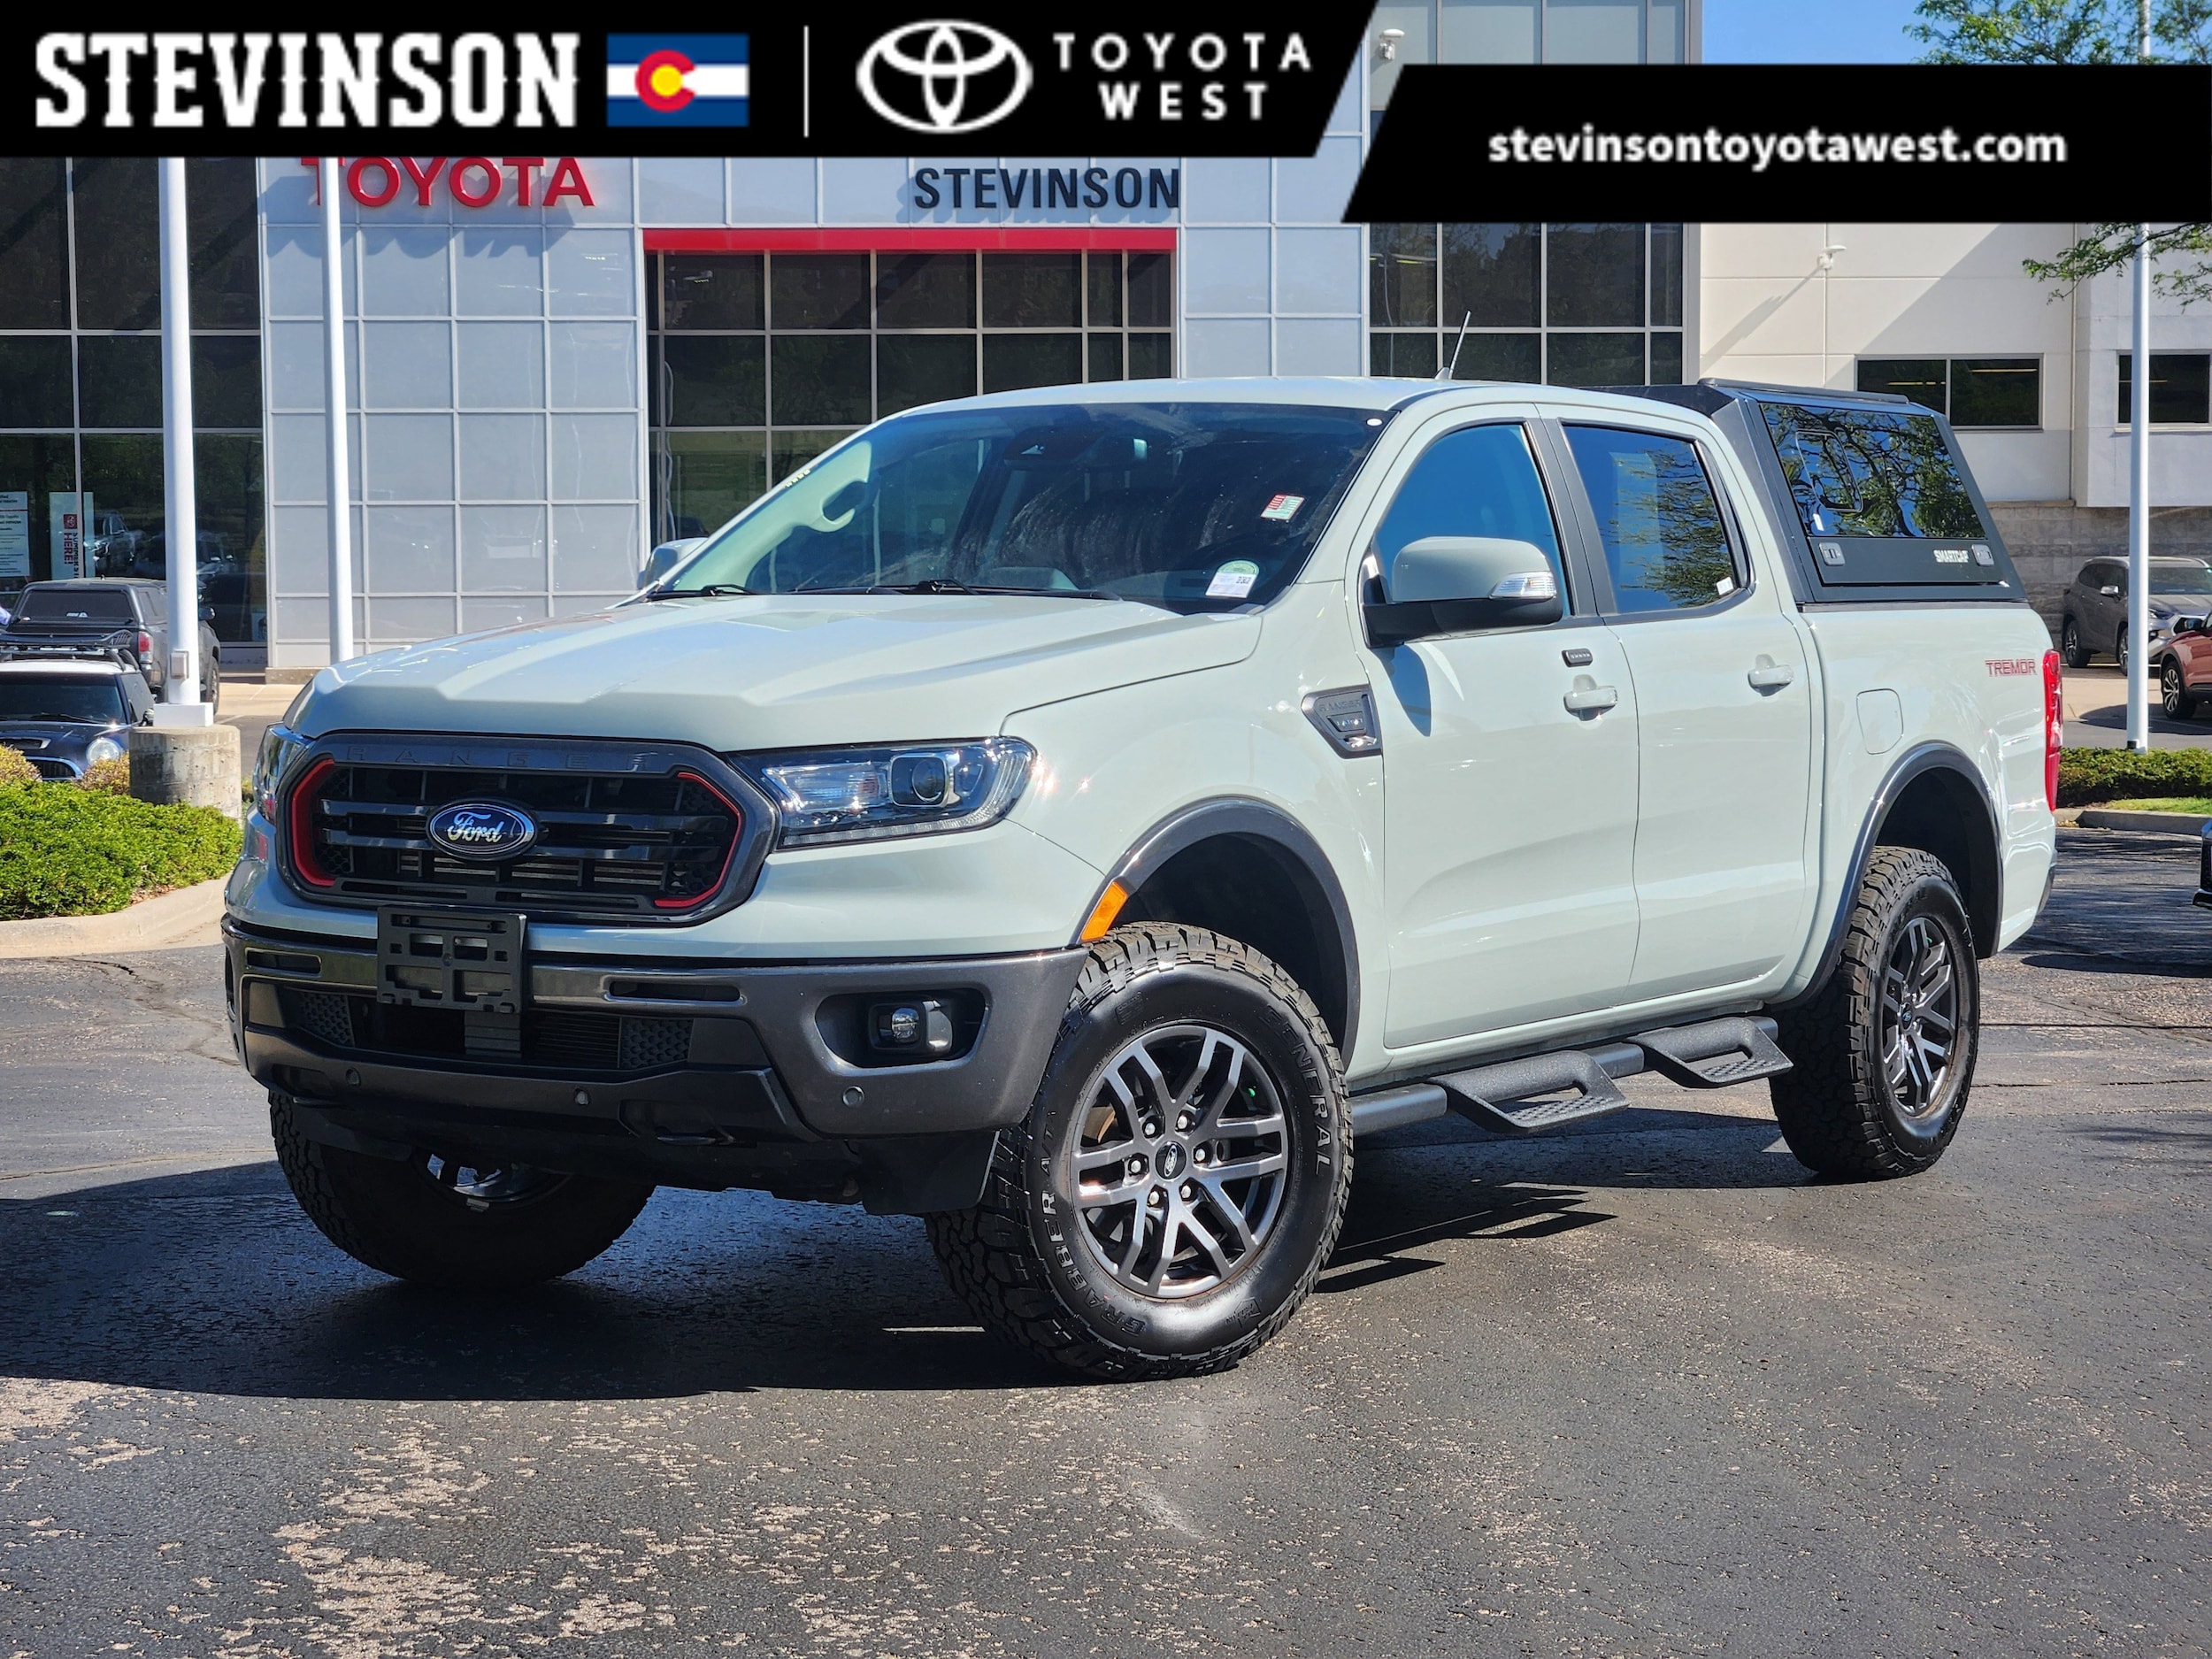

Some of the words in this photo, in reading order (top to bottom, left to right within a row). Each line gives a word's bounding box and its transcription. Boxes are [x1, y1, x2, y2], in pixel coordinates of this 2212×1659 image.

[914, 168, 1179, 209] STEVINSON
[64, 532, 73, 565] HERE!
[1985, 659, 2038, 677] TREMOR
[346, 745, 650, 772] RANGER
[446, 810, 505, 843] Ford
[1041, 1190, 1147, 1337] GRABBER
